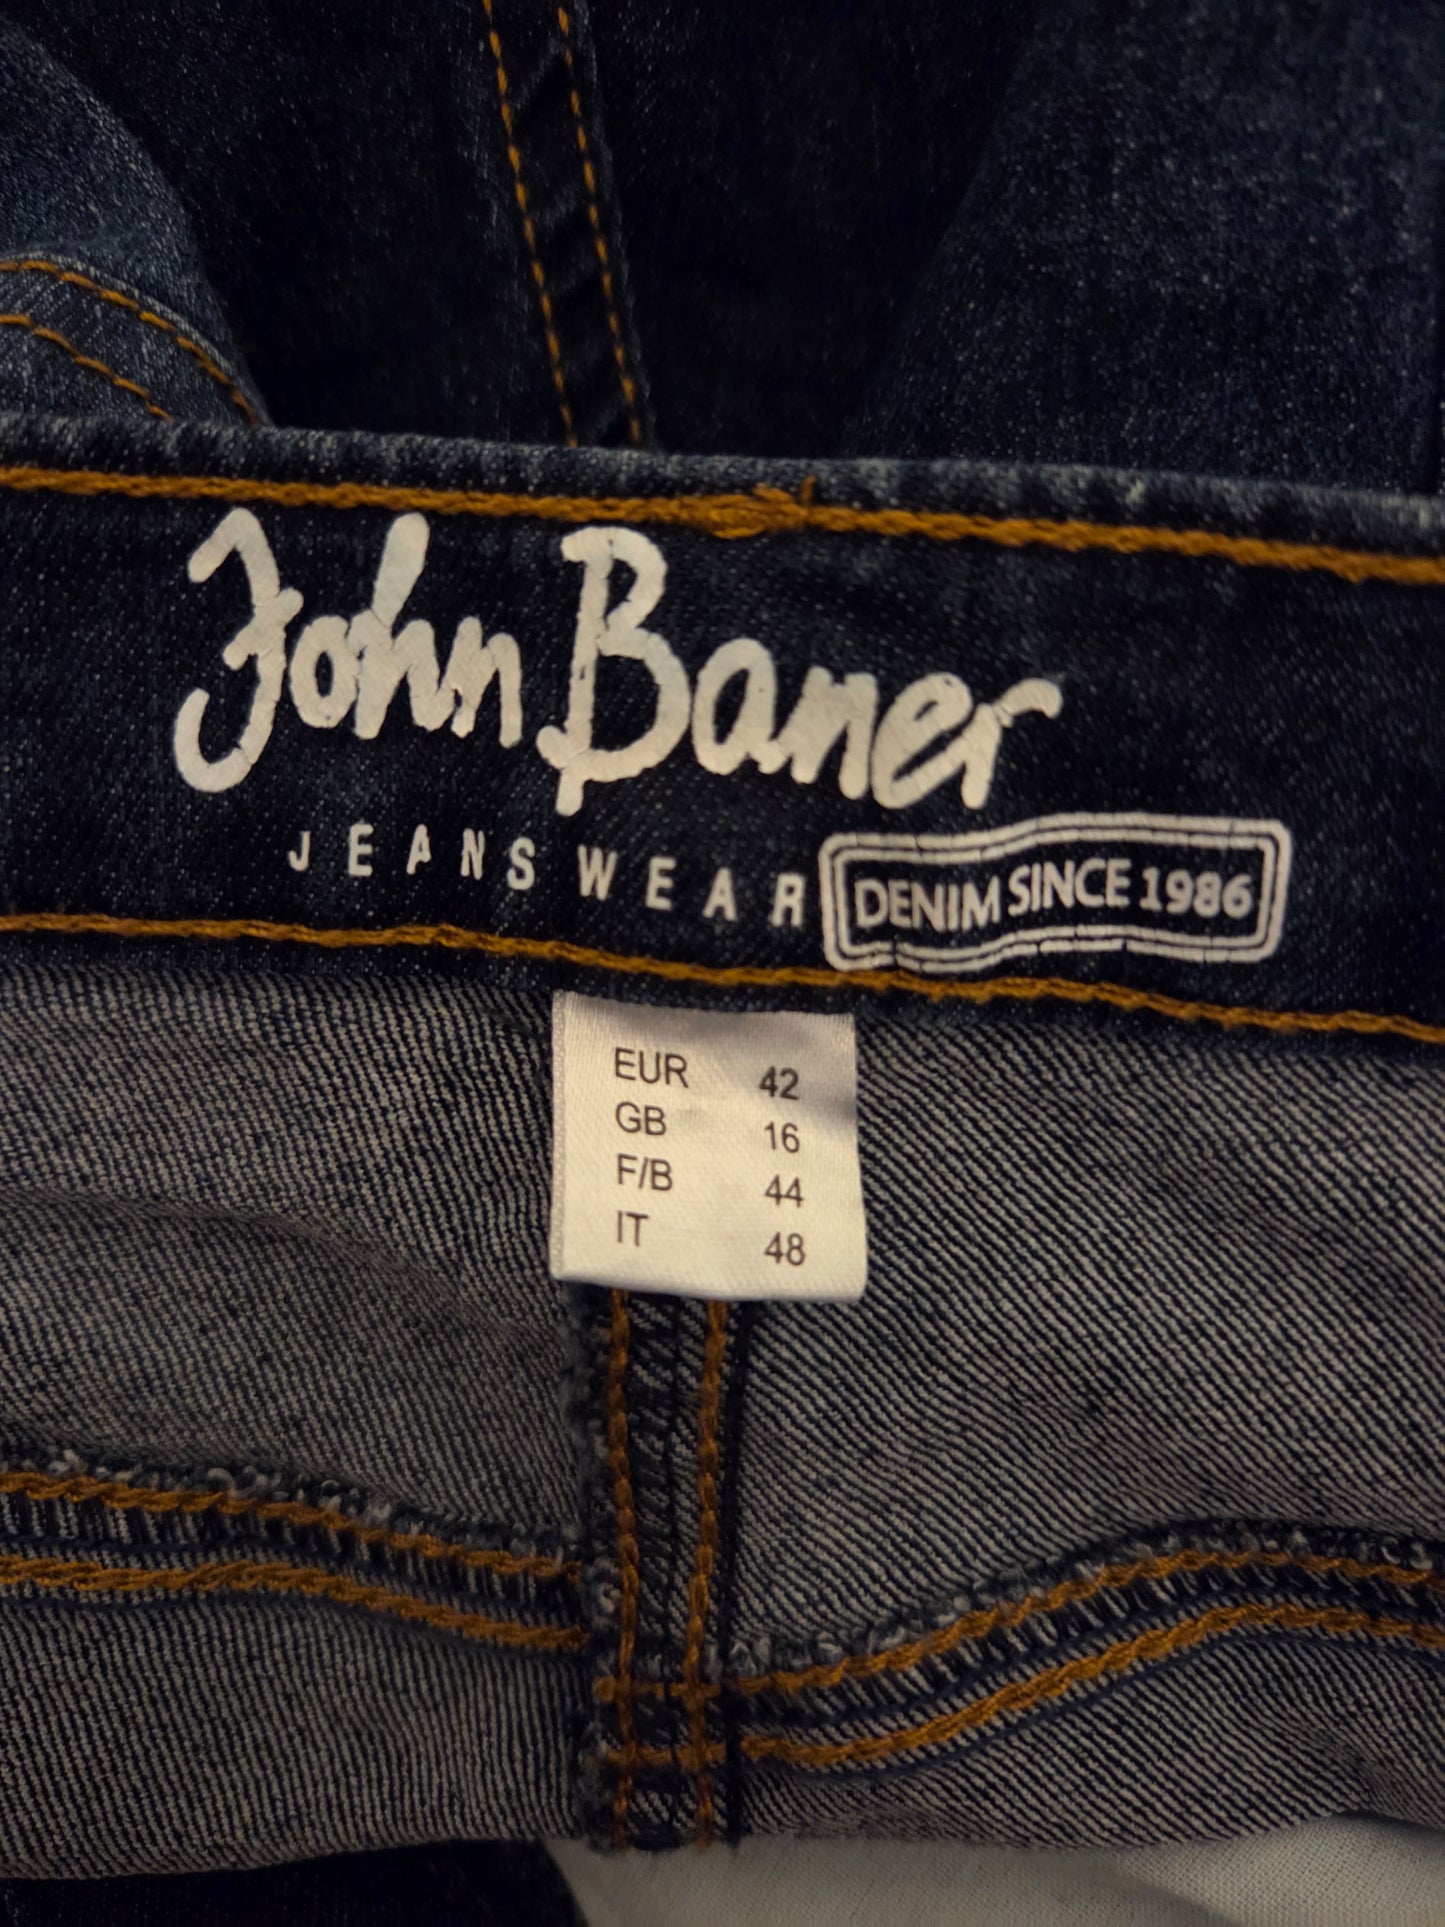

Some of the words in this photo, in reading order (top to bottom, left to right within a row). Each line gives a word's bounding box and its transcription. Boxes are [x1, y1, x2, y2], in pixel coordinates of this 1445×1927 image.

[174, 507, 522, 793] John
[536, 526, 1063, 817] Baner
[854, 876, 1000, 932] DENIM
[1007, 858, 1132, 917] SINCE
[1141, 866, 1254, 920] 1986
[614, 1047, 689, 1088] EUR
[759, 1065, 800, 1100] 42
[615, 1101, 667, 1136] GB
[764, 1121, 801, 1153] 16
[616, 1153, 673, 1192] F/B
[764, 1174, 804, 1208] 44
[616, 1210, 650, 1247] IT
[764, 1231, 806, 1266] 48
